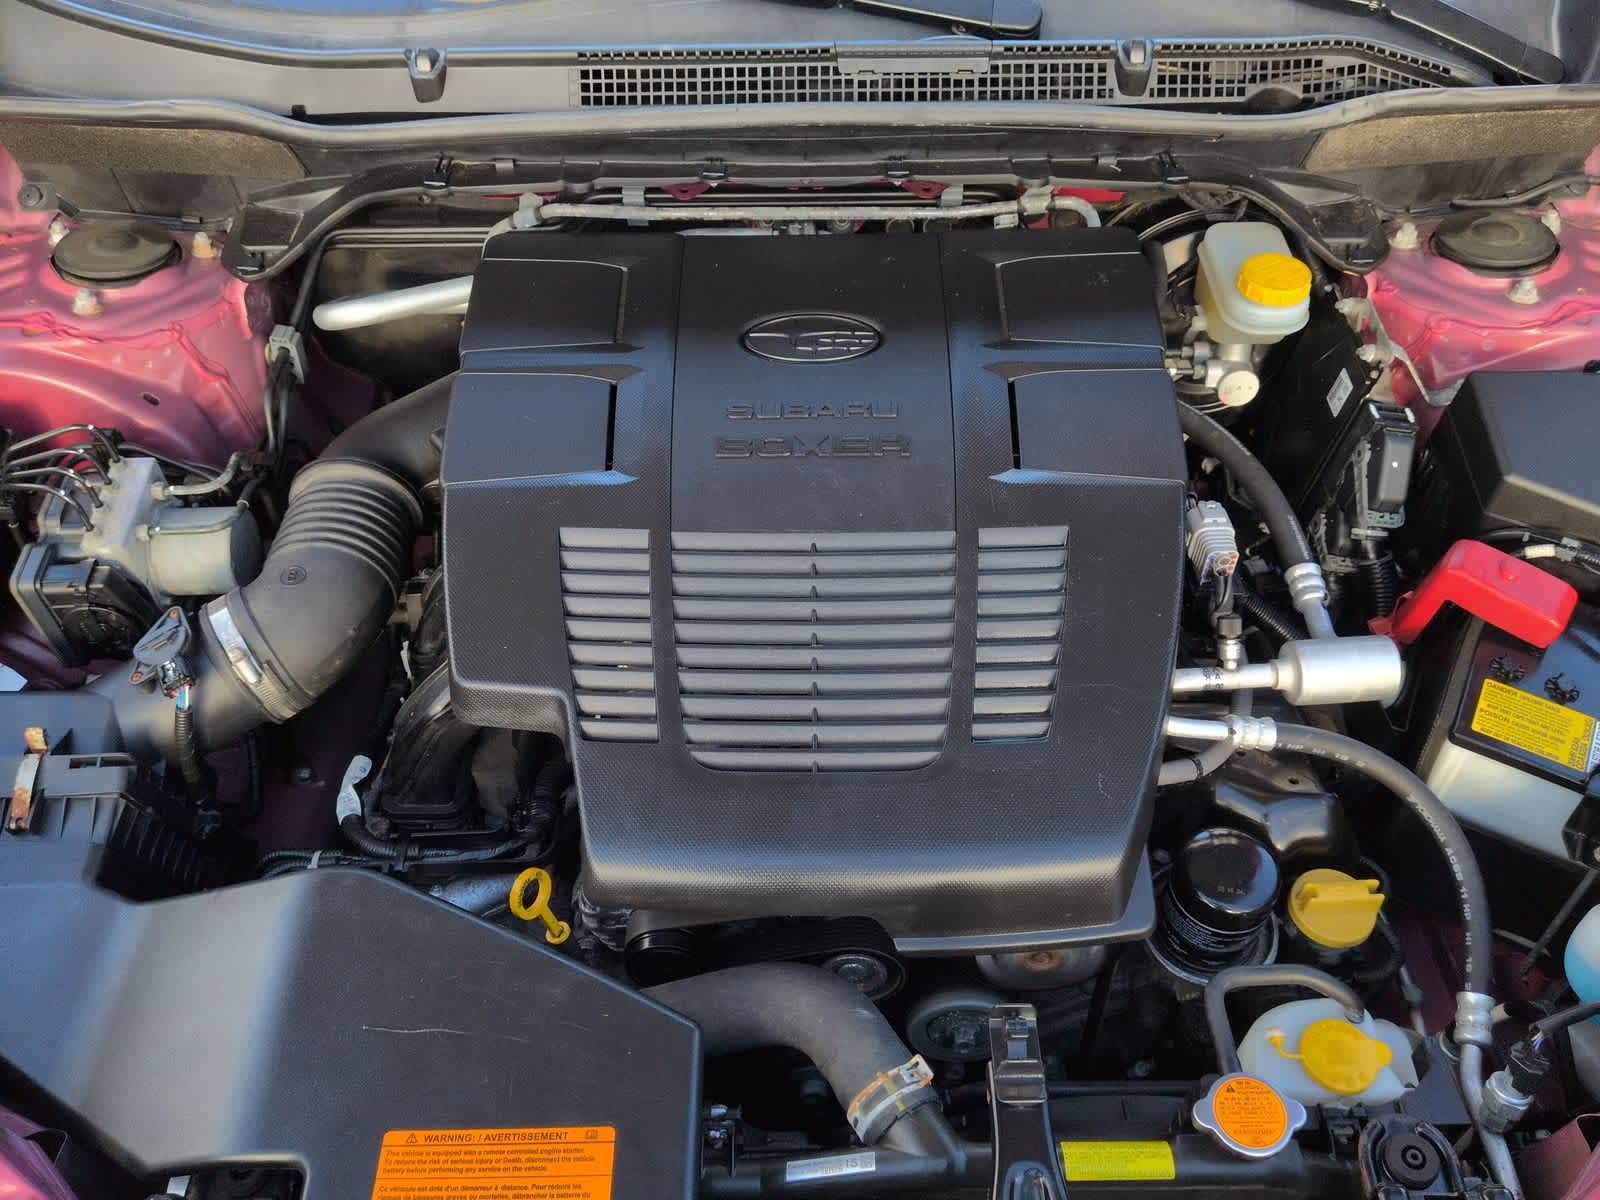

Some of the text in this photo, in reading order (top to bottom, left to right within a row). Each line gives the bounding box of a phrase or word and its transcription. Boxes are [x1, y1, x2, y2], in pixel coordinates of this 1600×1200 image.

[727, 402, 898, 419] SUBARU
[715, 436, 911, 458] BOXER
[424, 1133, 475, 1143] WARNING:
[484, 1132, 568, 1142] AVERTISSEMENT
